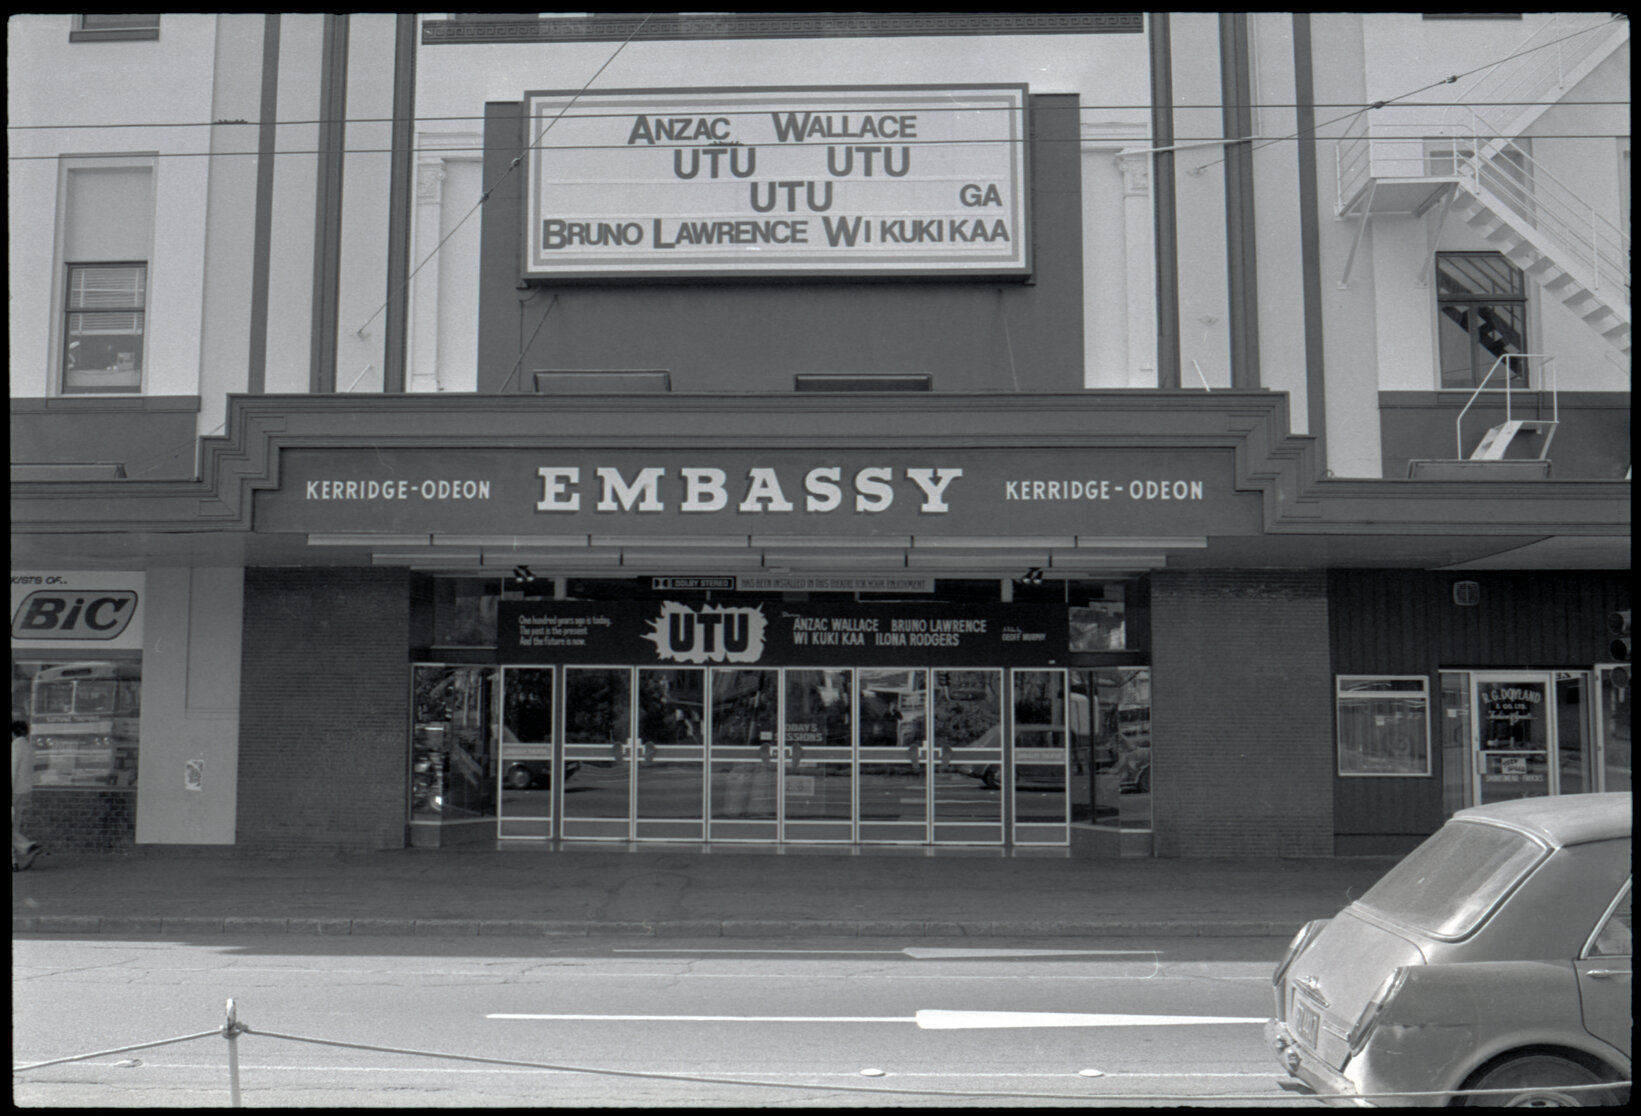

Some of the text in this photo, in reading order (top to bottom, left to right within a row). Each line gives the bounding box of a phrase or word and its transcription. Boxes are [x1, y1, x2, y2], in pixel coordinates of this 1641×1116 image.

[628, 112, 917, 144] ANZAC WALLACE
[673, 147, 911, 179] UTU UTU
[750, 181, 1003, 212] UTU GA
[543, 219, 644, 249] BRUNO
[653, 218, 808, 249] LAWRENCE
[306, 480, 490, 500] KERRIDGE-ODEON
[537, 466, 963, 513] EMBASSY
[700, 578, 729, 588] STEREO
[669, 613, 749, 653] UTU
[793, 618, 828, 631] ANZAC
[831, 618, 879, 632] WALLACE
[891, 619, 927, 632] BRUNO
[929, 619, 987, 633] LAWRENCE
[793, 632, 960, 647] WI KUKI KAA ILONA RODGERS
[774, 733, 823, 742] SSSIONS
[785, 723, 818, 732] ODAYS
